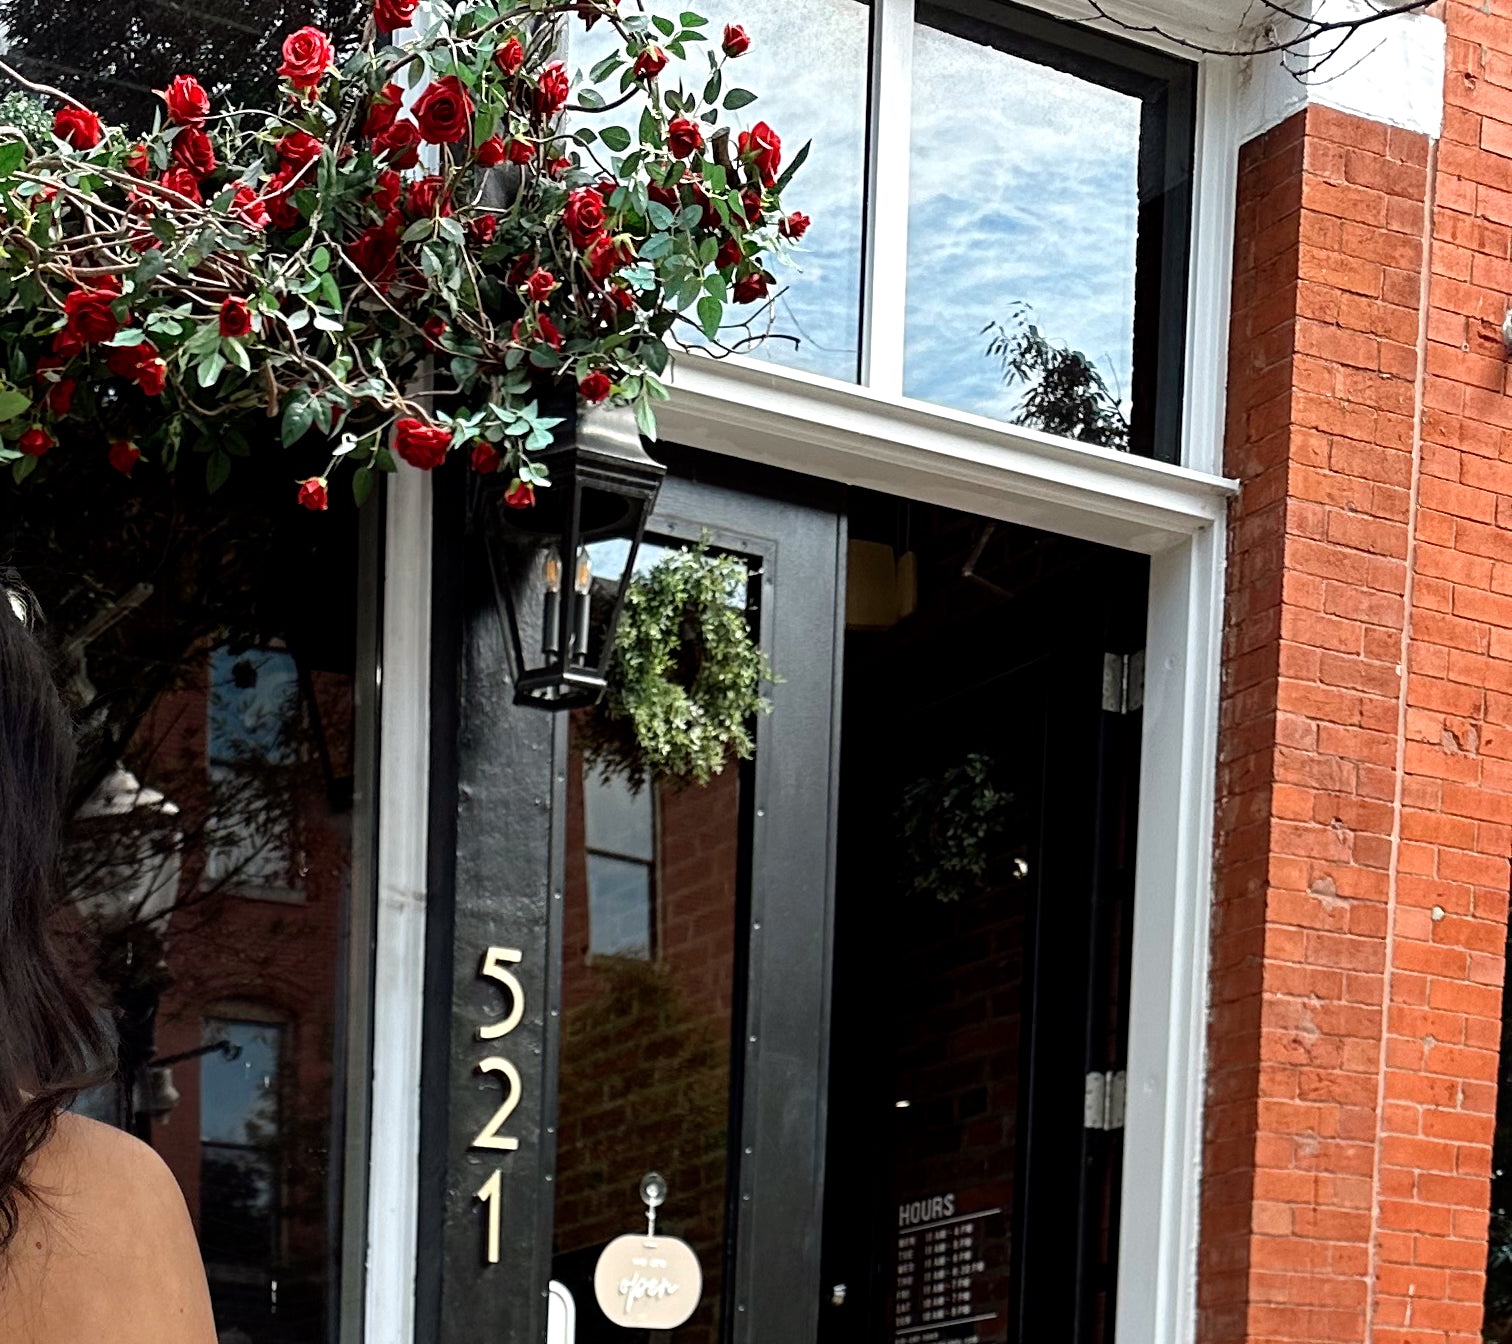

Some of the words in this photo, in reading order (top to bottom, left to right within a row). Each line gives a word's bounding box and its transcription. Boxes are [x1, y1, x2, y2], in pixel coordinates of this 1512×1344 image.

[469, 946, 525, 1264] 521
[898, 1193, 956, 1227] HOURS
[618, 1272, 680, 1314] open
